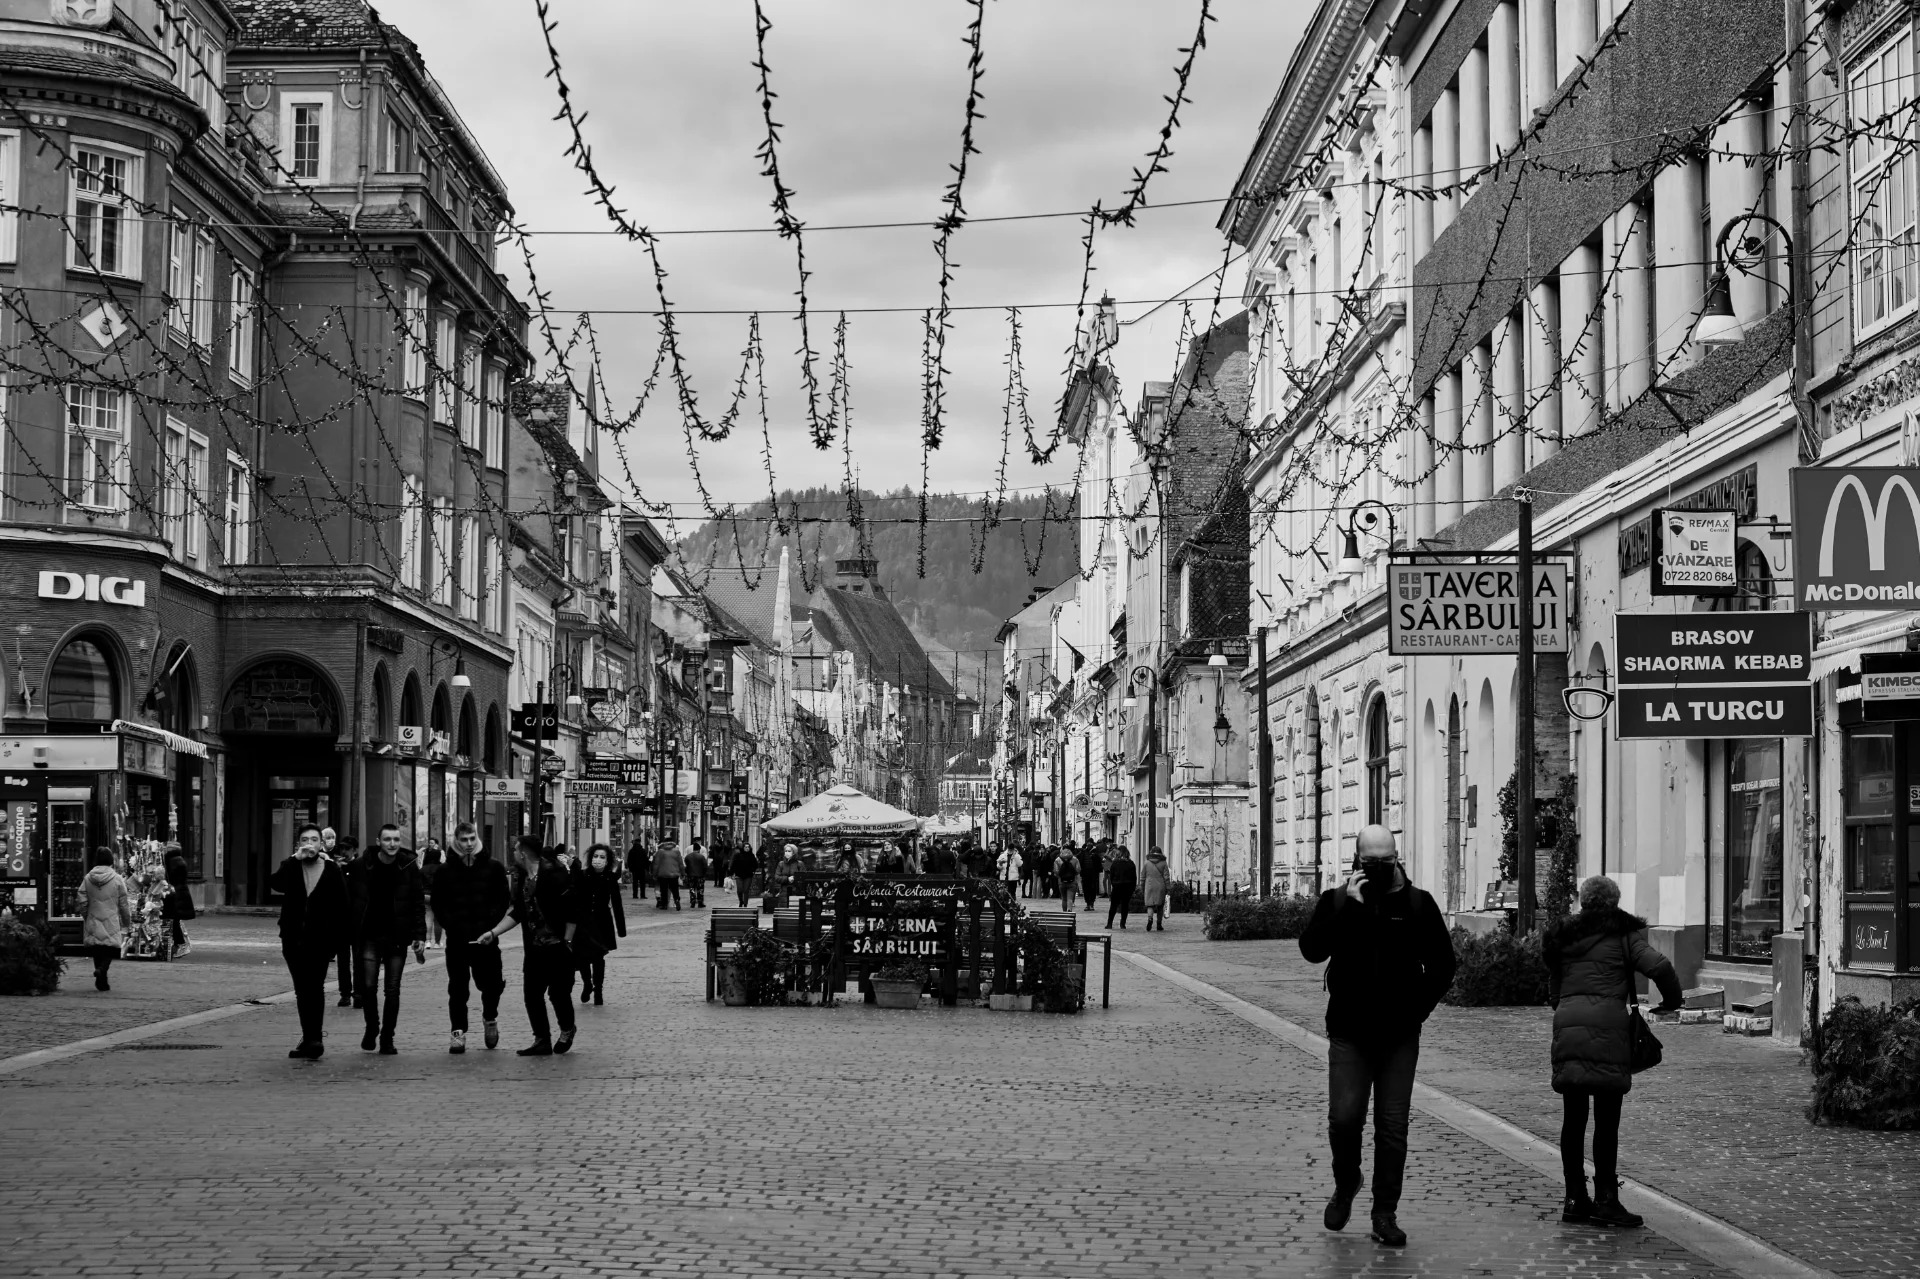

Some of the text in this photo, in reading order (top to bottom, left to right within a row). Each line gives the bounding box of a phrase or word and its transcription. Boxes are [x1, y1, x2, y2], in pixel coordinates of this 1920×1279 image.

[1689, 519, 1729, 528] RE/MAX
[1690, 539, 1709, 551] DE
[1665, 552, 1733, 568] VÂNZARE
[1664, 571, 1734, 582] 0722 820 684
[38, 570, 145, 607] DIGI
[1423, 571, 1558, 598] TAVERA
[1671, 630, 1754, 646] BRASOV
[1624, 654, 1804, 672] SHAORMA KEBAB
[1645, 700, 1784, 722] LA TURCU
[631, 772, 646, 782] ICE
[572, 782, 615, 792] EXCHANGE
[867, 917, 937, 932] TAERNA
